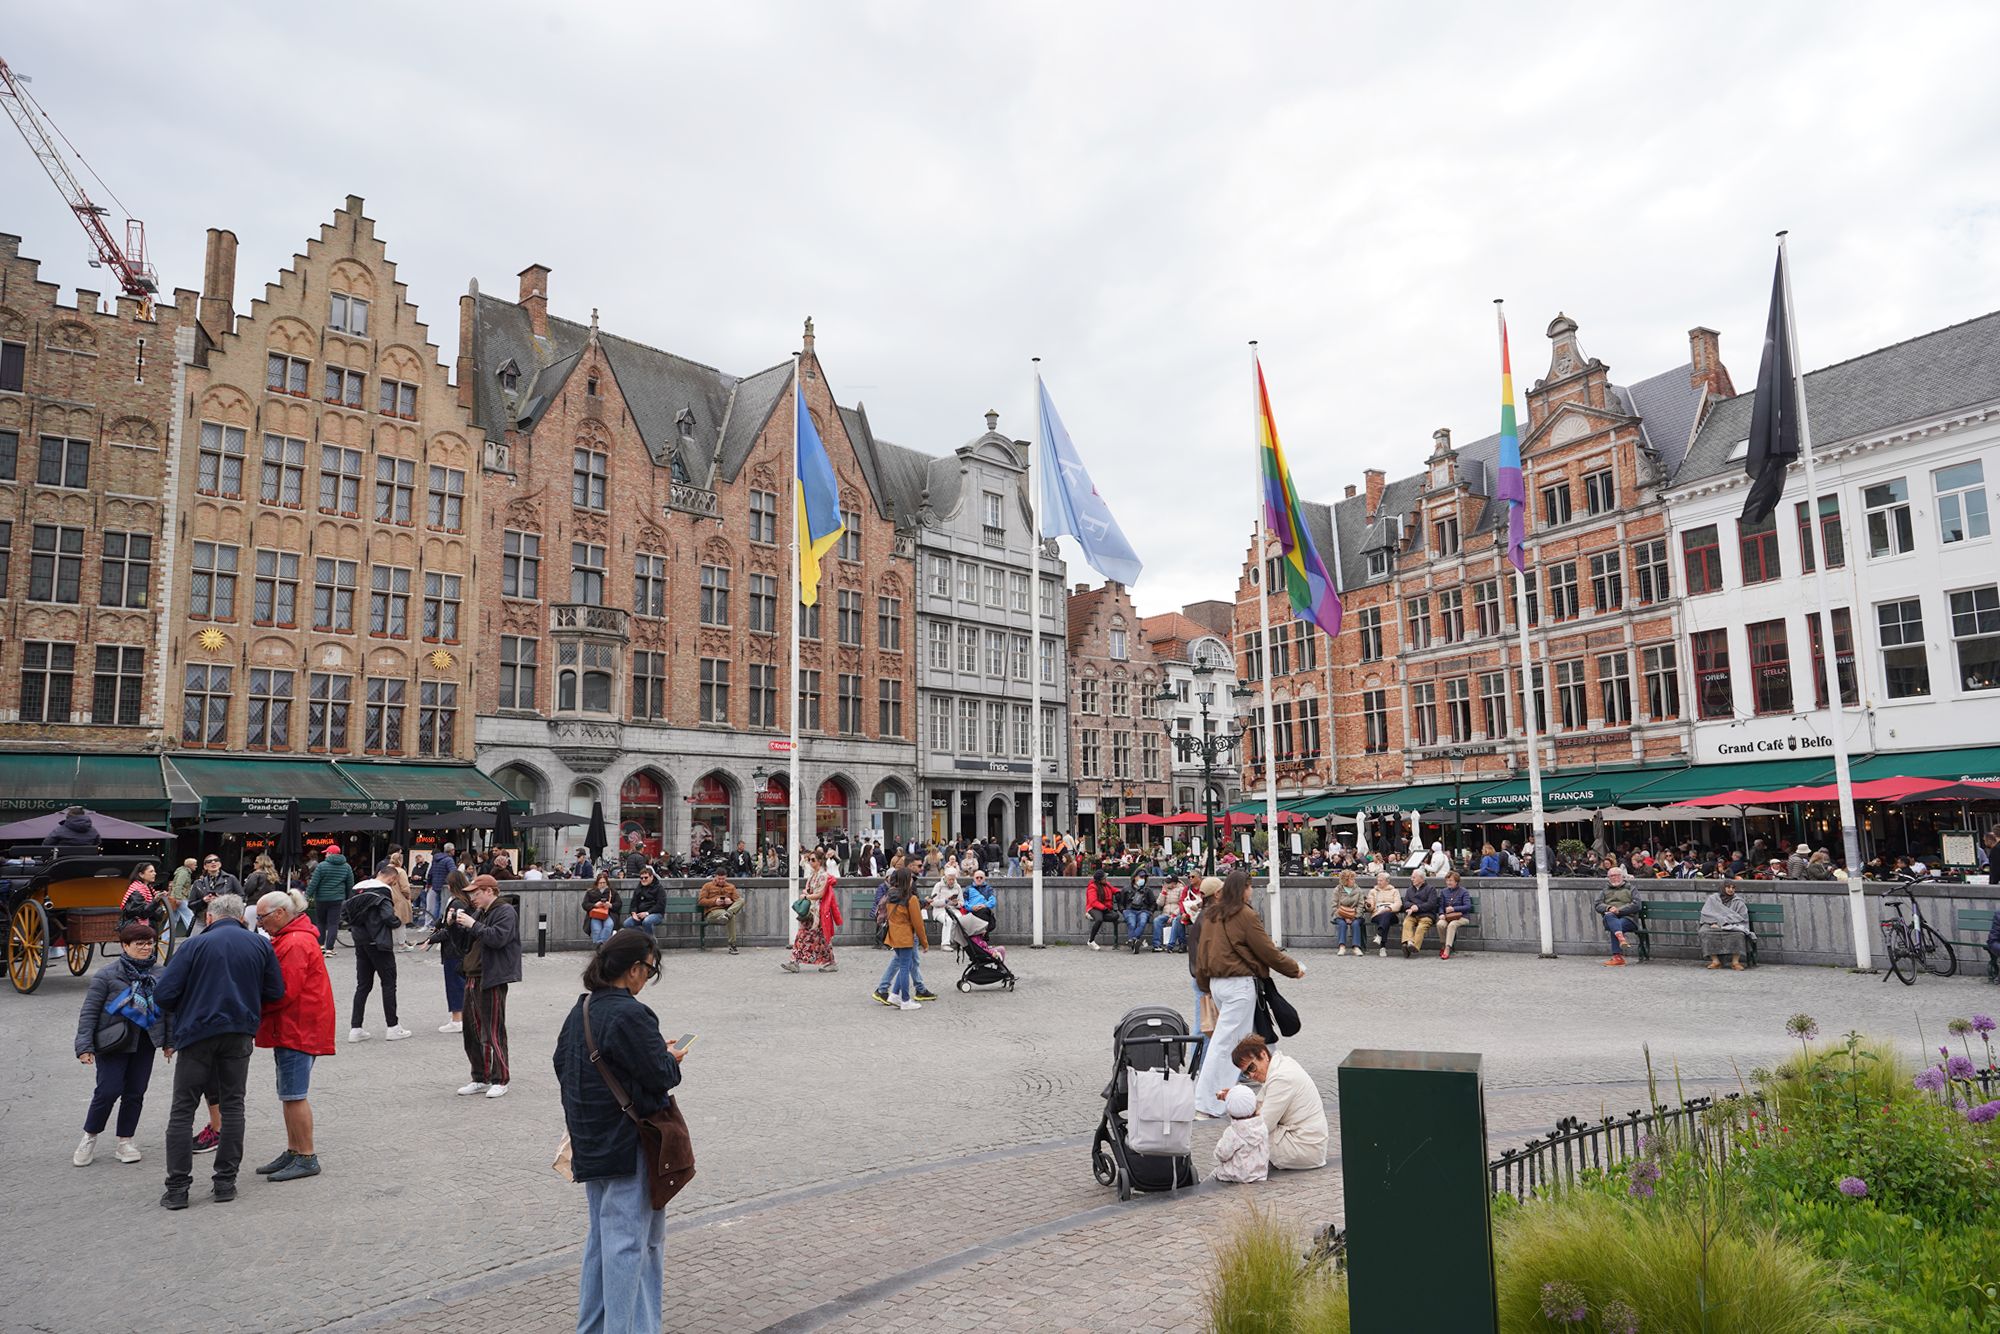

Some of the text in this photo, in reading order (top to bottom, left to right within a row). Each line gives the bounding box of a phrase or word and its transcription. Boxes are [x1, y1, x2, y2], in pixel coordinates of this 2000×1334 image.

[1763, 668, 1787, 676] STELLA
[1718, 736, 1833, 755] Grand Café Belfo
[989, 761, 1009, 772] fnac
[1549, 791, 1595, 801] FRANÇAIS
[1364, 804, 1400, 813] DA MARIO
